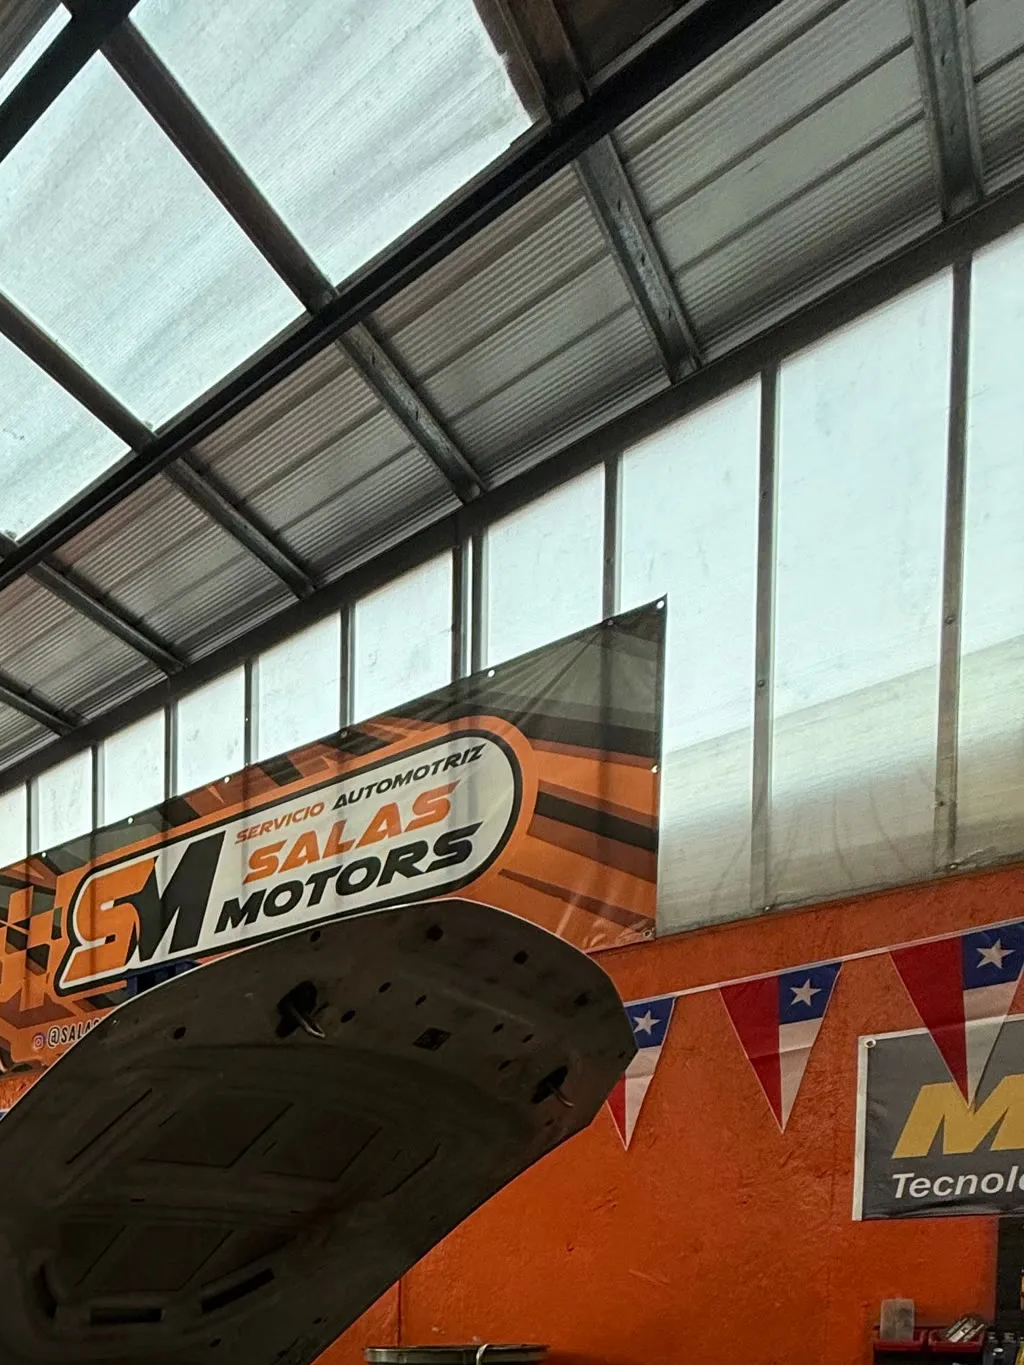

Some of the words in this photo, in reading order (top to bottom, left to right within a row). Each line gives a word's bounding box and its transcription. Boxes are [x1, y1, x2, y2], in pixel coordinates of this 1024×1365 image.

[235, 802, 325, 844] SERVICIO
[331, 744, 487, 811] AUTOMOTRIZ
[243, 780, 461, 884] SALAS
[215, 821, 483, 934] MOTORS
[892, 1166, 1024, 1198] Tecnol
